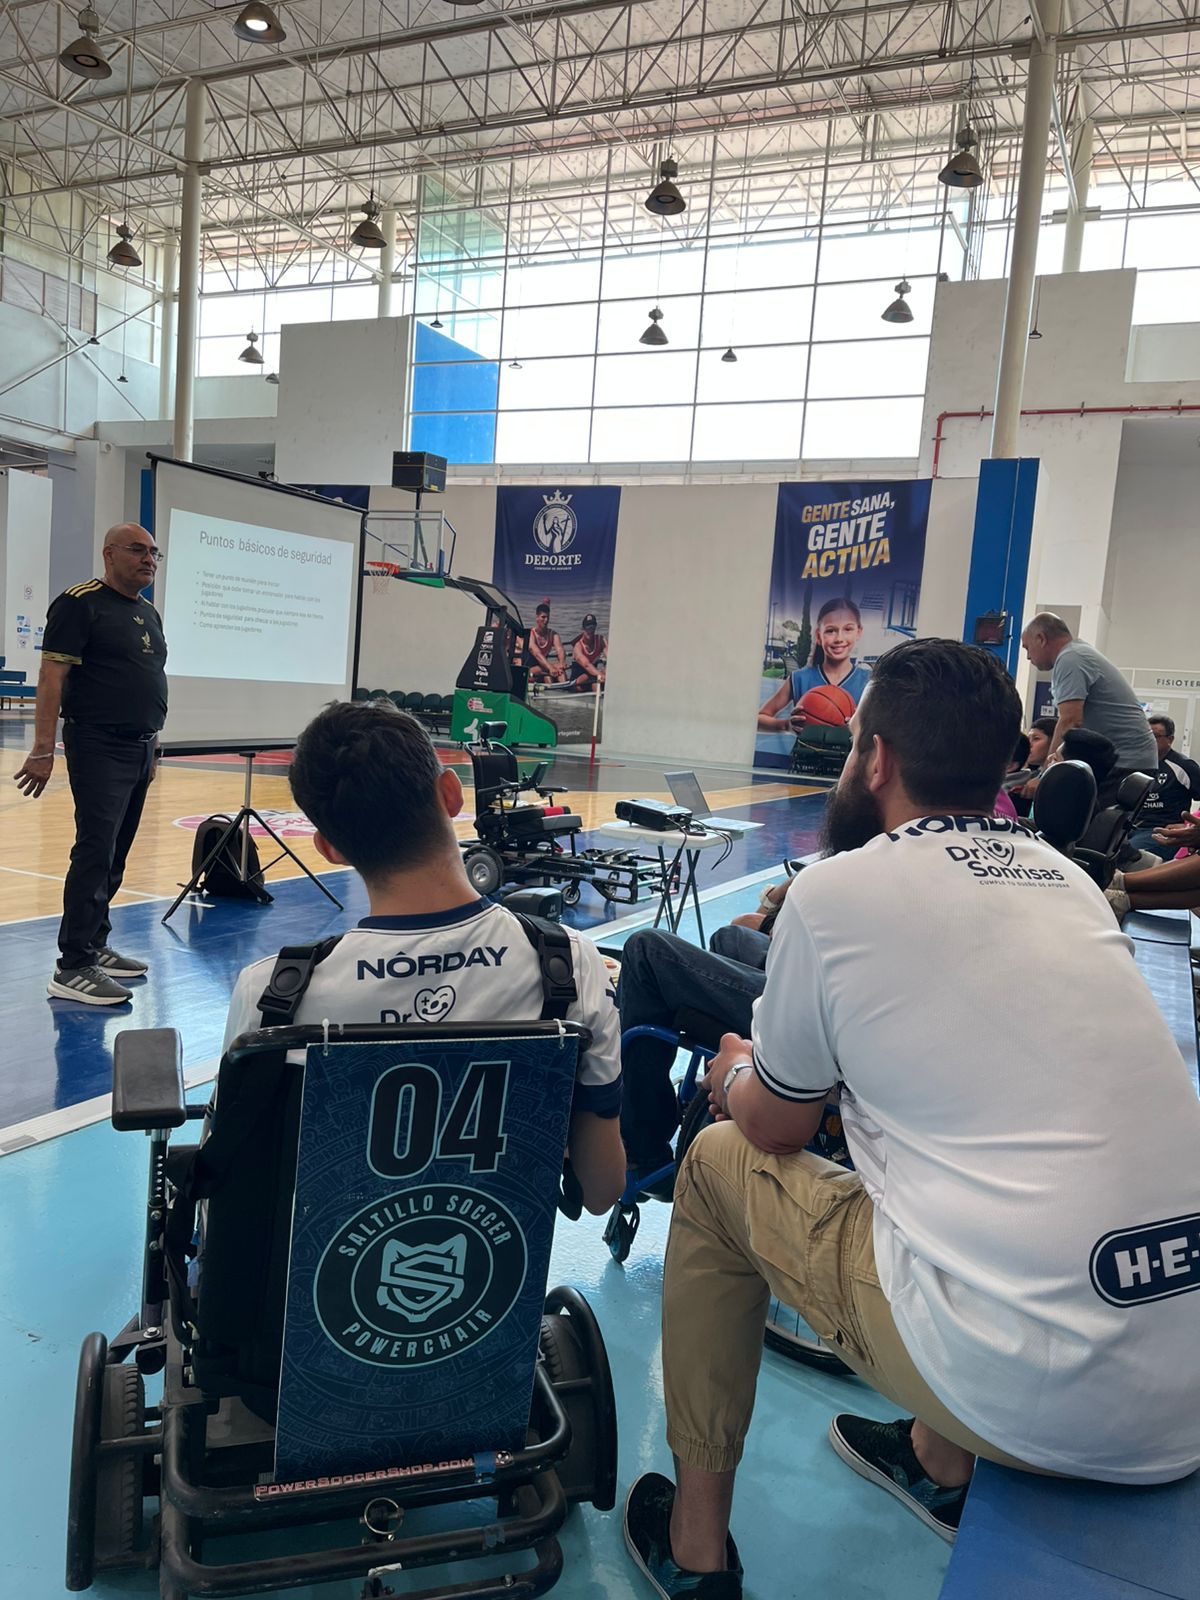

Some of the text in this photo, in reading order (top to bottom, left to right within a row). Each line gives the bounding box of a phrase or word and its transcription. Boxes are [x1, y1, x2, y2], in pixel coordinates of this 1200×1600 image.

[802, 492, 896, 523] GENTE SANA,
[200, 530, 332, 565] Puntos básicos de seguridad
[807, 511, 887, 551] GENTE
[525, 554, 582, 566] DEPORTE
[801, 537, 890, 579] ACTIVA
[945, 846, 989, 862] Dr.
[967, 860, 1065, 882] Sonrisas
[366, 1060, 512, 1180] 04
[338, 1194, 512, 1257] SALTILLO SOCCER
[342, 1307, 492, 1358] POWERCHAIR
